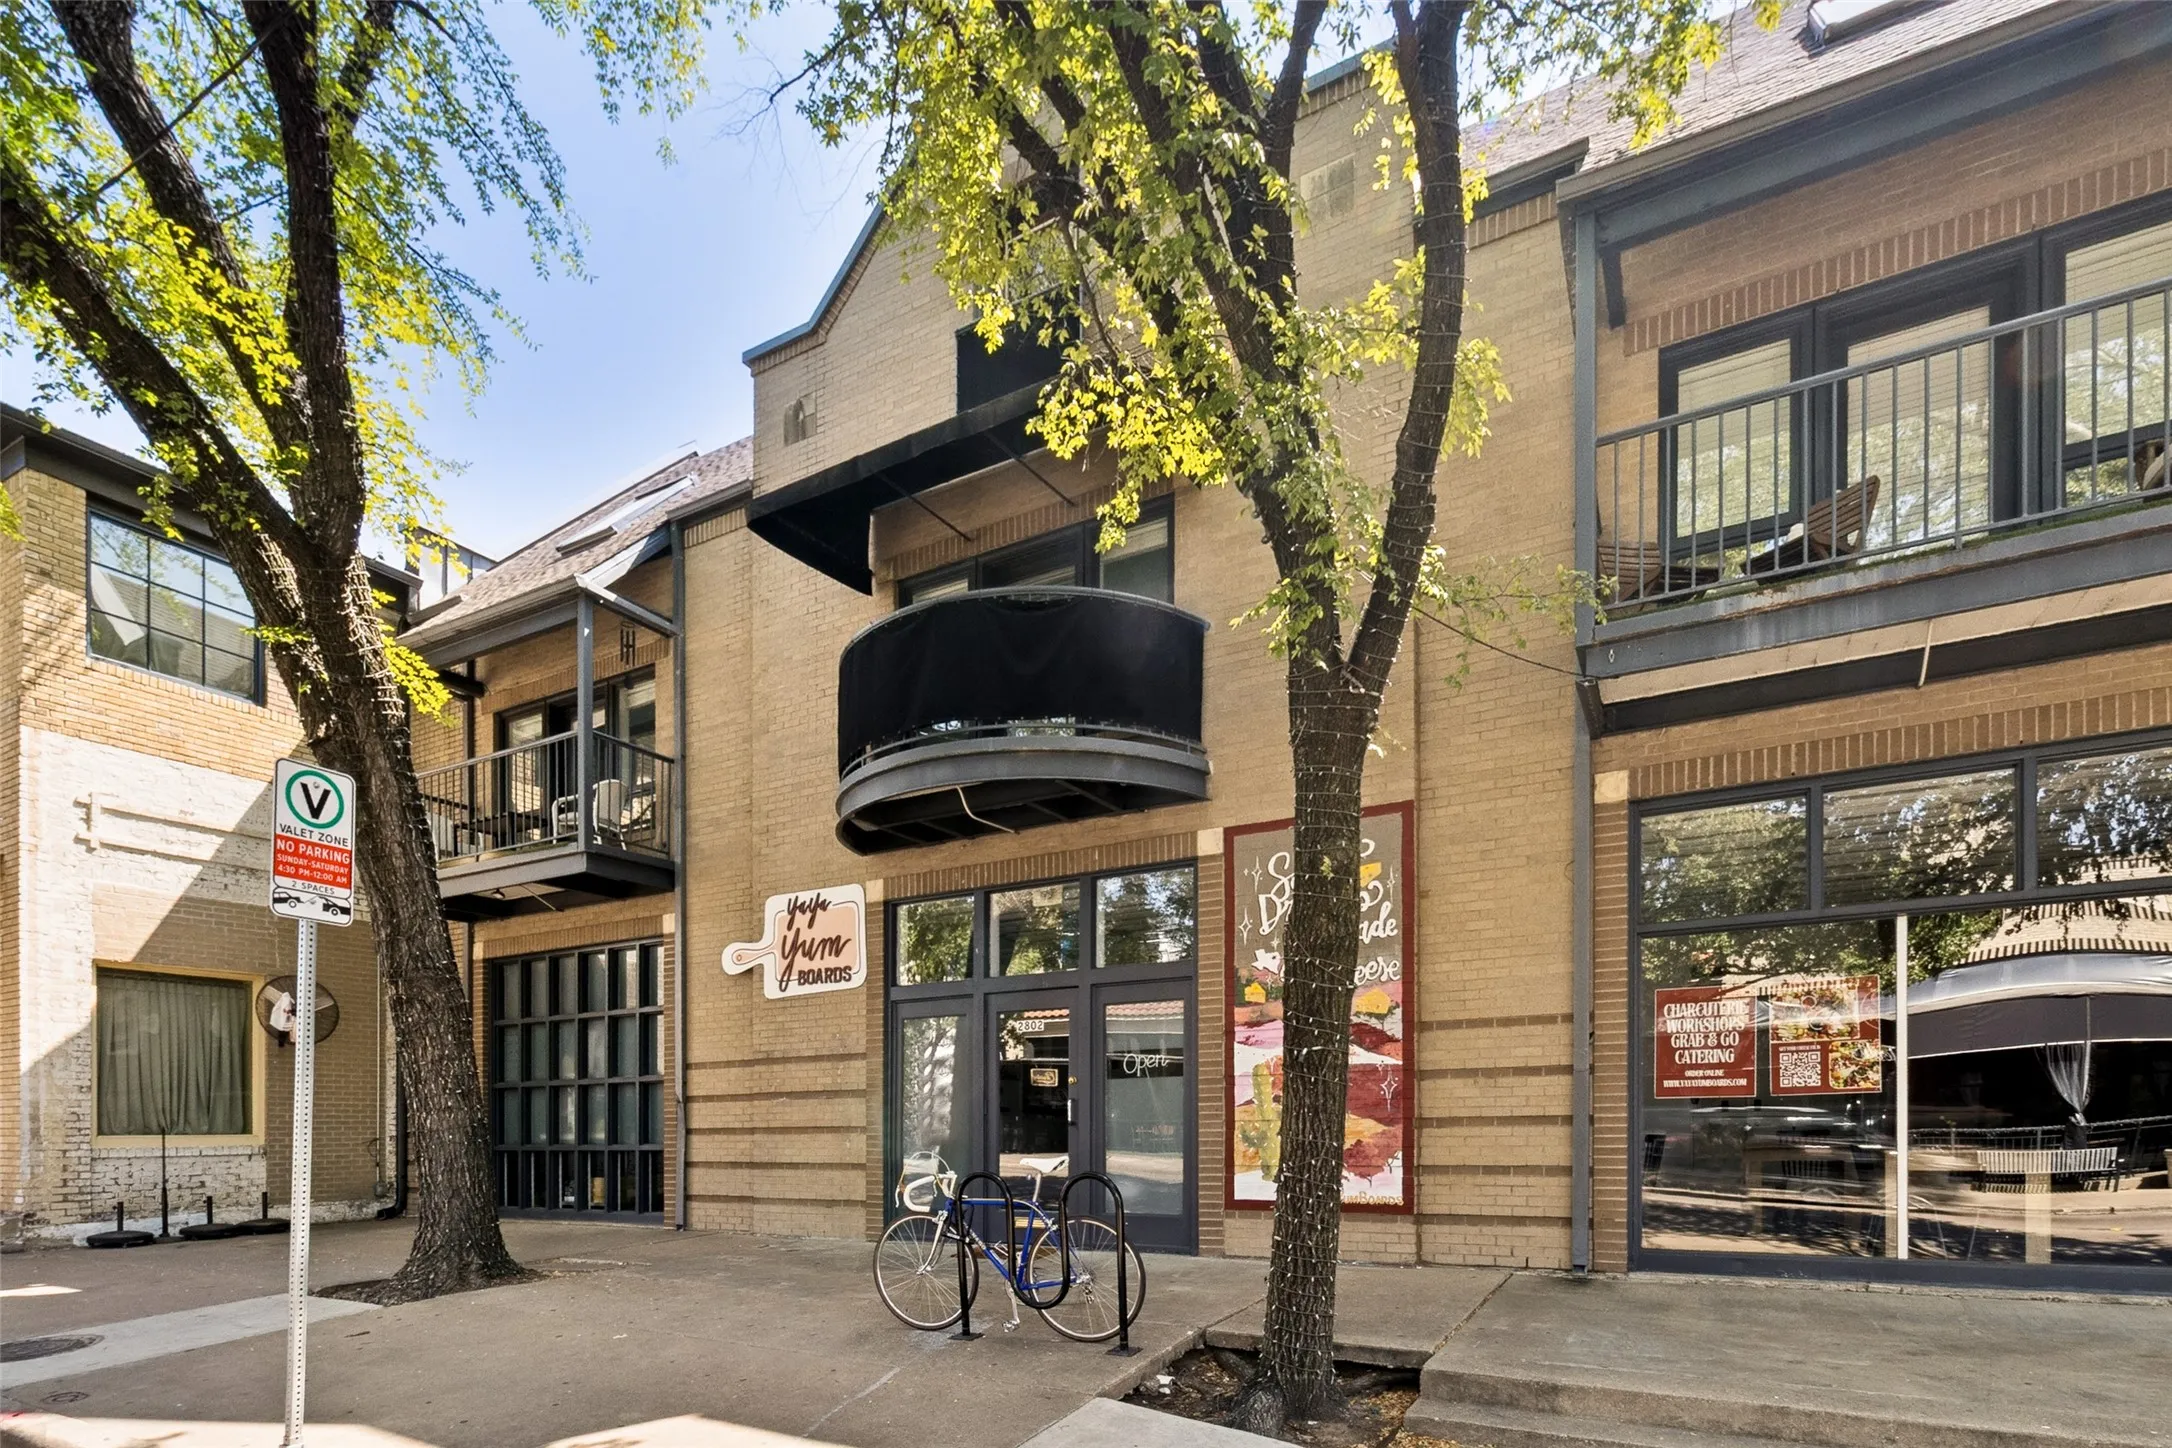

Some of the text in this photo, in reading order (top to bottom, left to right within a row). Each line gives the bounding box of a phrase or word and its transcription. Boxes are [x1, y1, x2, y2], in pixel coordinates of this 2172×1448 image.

[300, 782, 332, 820] V
[280, 823, 349, 847] VALET ZONE
[276, 838, 351, 865] NO PARKING
[277, 853, 349, 875] SUNDAY-SATURDAY
[278, 864, 296, 874] 4:30
[336, 876, 347, 884] AM
[301, 882, 335, 895] SPACES
[798, 966, 852, 986] BOARDS
[1663, 1000, 1749, 1018] CHARCUTERIE
[1017, 1020, 1043, 1031] 2802
[1666, 1016, 1746, 1034] WORKSHOPS
[1670, 1031, 1740, 1048] GRAB & GO
[1123, 1053, 1169, 1077] Open
[1675, 1048, 1735, 1064] CATERING
[1704, 1069, 1725, 1077] ONLINE
